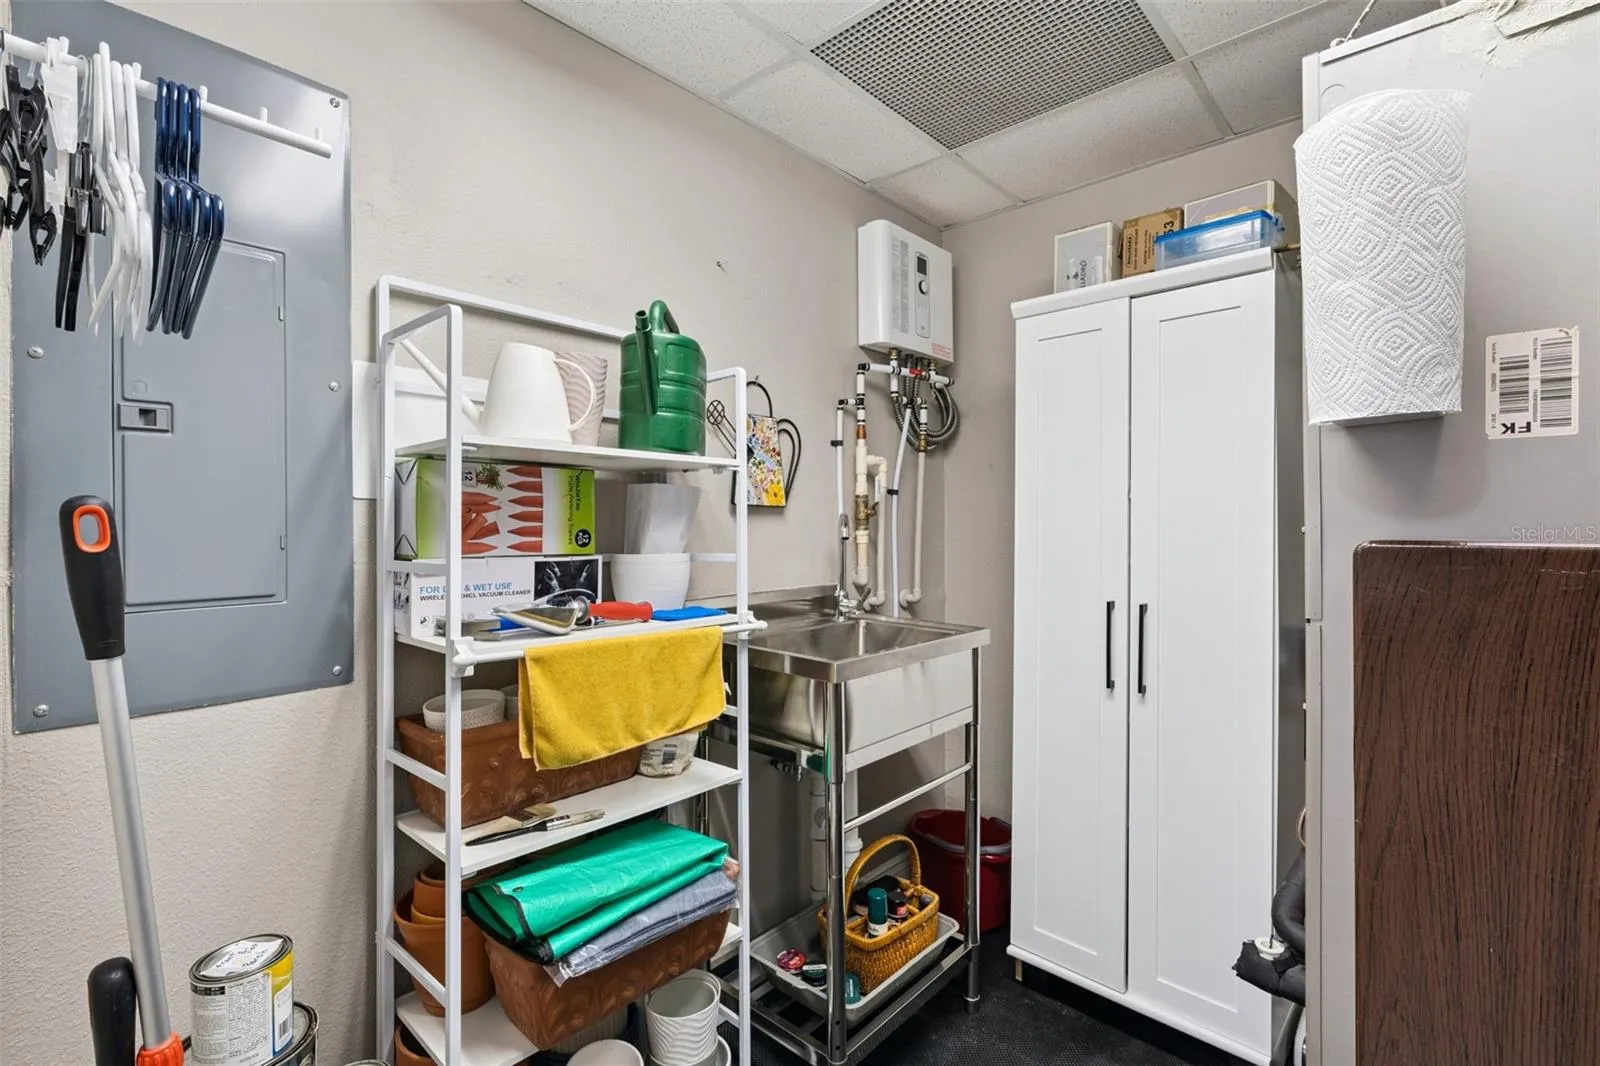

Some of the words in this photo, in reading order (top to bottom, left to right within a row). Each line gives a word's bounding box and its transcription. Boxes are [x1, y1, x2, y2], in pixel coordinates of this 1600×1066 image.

[1500, 421, 1532, 435] FK
[465, 471, 474, 481] 12
[582, 533, 589, 543] 12
[419, 585, 440, 594] FOR
[464, 584, 470, 592] &
[473, 583, 492, 592] WET
[495, 582, 513, 591] USE
[504, 589, 532, 597] CLEANER
